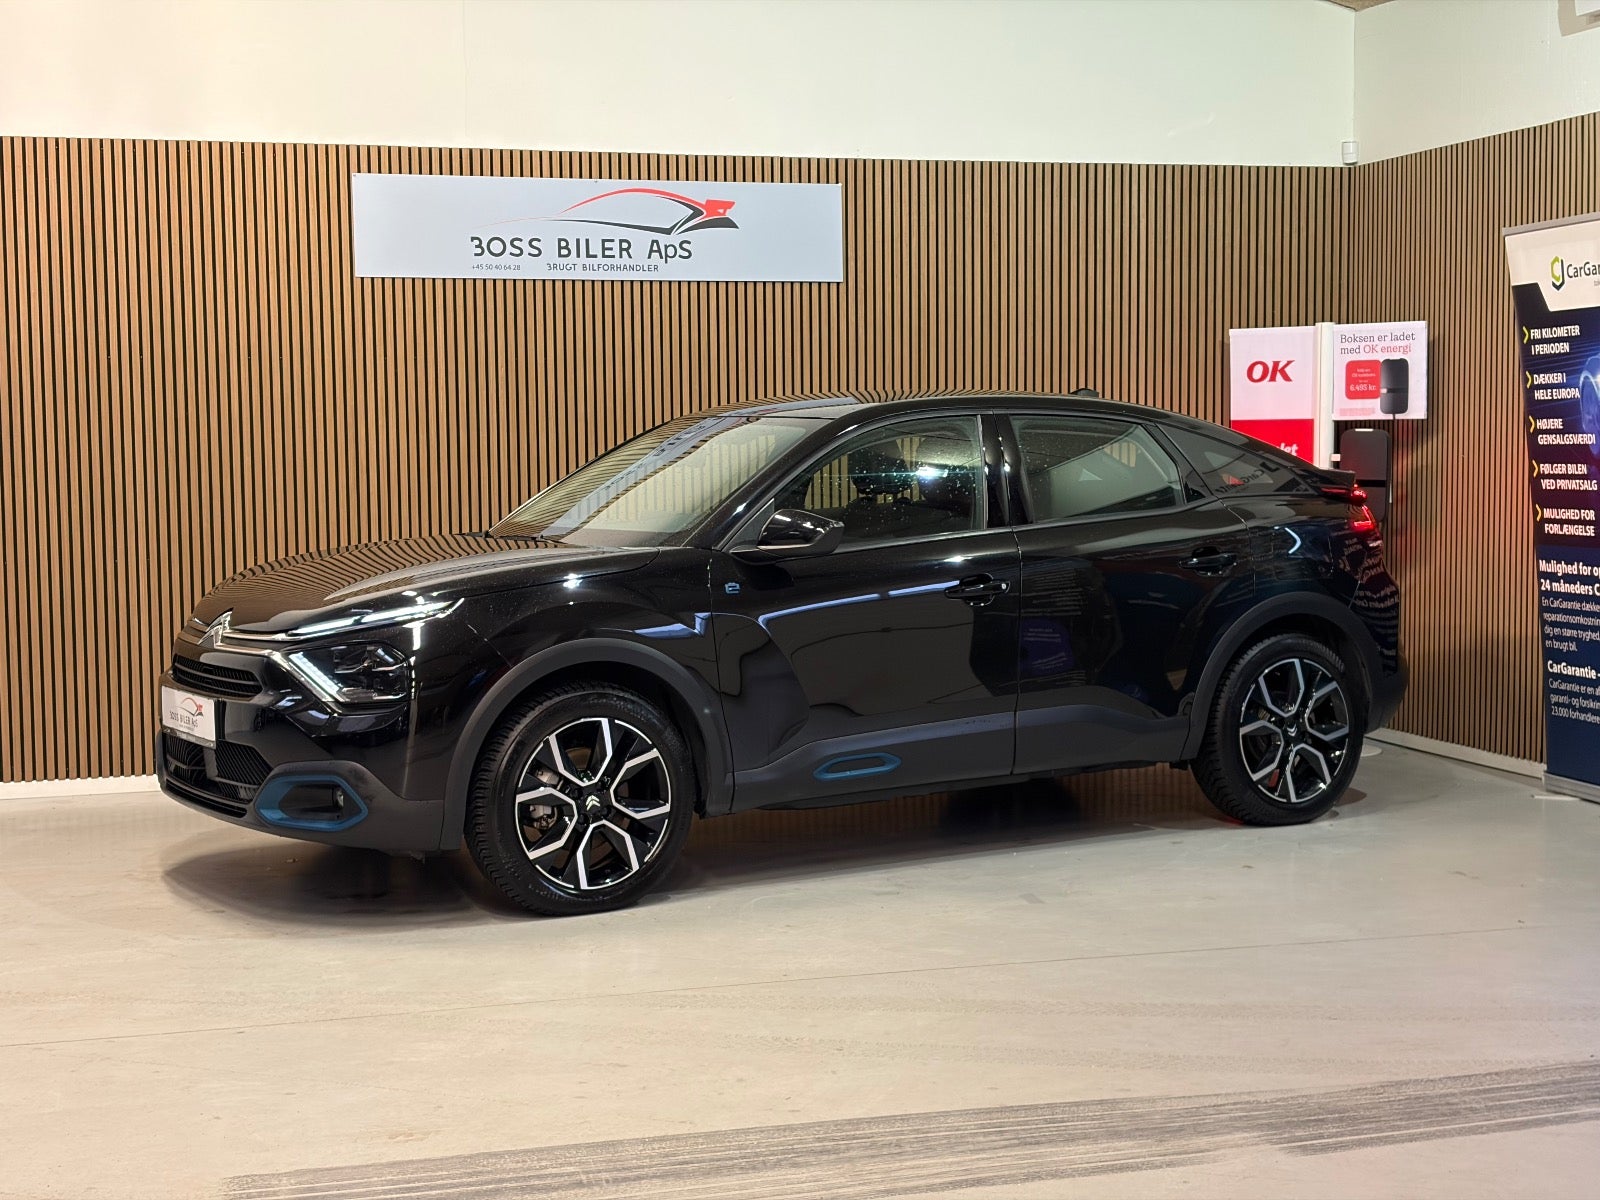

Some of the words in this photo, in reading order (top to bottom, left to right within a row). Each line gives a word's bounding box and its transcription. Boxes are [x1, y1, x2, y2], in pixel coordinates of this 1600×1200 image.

[557, 237, 633, 259] BILER
[647, 239, 693, 263] ApS
[472, 263, 484, 271] +45
[485, 263, 494, 271] 50
[582, 263, 659, 272] BILFORHANDLER
[1340, 333, 1375, 344] Boksen
[1390, 332, 1416, 342] ladet
[1530, 328, 1542, 340] FRI
[1542, 324, 1580, 339] KILOMETER
[1340, 345, 1361, 354] med
[1363, 344, 1378, 354] OK
[1380, 343, 1412, 354] energi
[1531, 344, 1535, 356] I
[1535, 342, 1570, 355] PERIODEN
[1246, 360, 1296, 383] OK
[1533, 372, 1563, 385] DÆKKER
[1534, 389, 1552, 400] HELE
[1552, 388, 1580, 400] EUROPA
[1536, 418, 1563, 430] HØJERE
[1538, 434, 1596, 445] GENSALGSVÆRDI
[1540, 463, 1566, 475] FØLGER
[1567, 463, 1587, 475] BILEN
[1541, 478, 1556, 490] VED
[1556, 479, 1598, 491] PRIVATSALG
[1543, 508, 1580, 520] MULIGHED
[1580, 509, 1595, 521] FOR
[1544, 523, 1595, 537] FORLÆNGELSE
[1539, 559, 1578, 576] Mulighed
[1579, 562, 1592, 576] for
[1540, 578, 1550, 592] 24
[1552, 579, 1593, 596] måneders
[1550, 597, 1581, 610] CarGarantie
[1544, 624, 1554, 637] dig
[1554, 627, 1561, 636] en
[1552, 638, 1568, 652] brugt
[1547, 659, 1596, 680] CarGarantie
[1549, 678, 1580, 693] CarGarantie
[1572, 697, 1579, 709] og
[1551, 705, 1569, 718] 23.000
